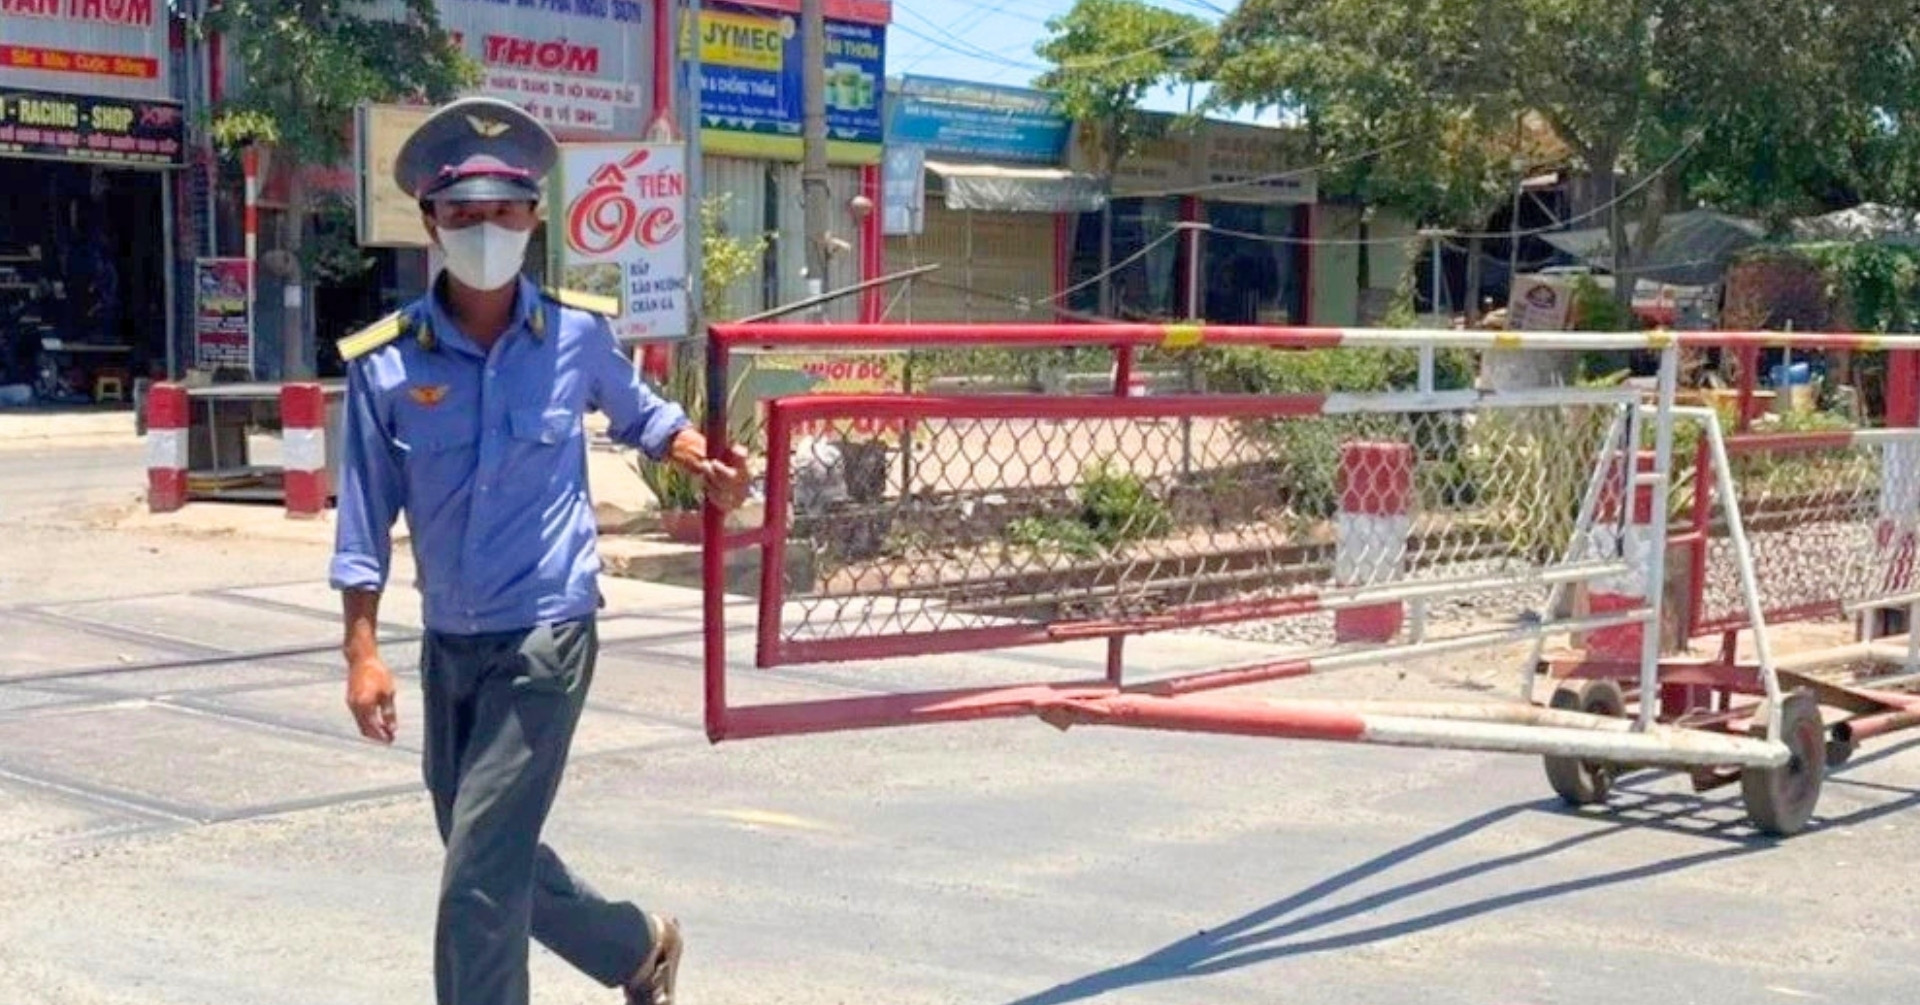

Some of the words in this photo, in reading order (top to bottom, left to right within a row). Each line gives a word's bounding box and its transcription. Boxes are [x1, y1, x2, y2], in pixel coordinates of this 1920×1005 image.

[703, 22, 779, 51] JYMEC
[19, 99, 78, 128] RACING
[92, 105, 133, 131] SHOP
[637, 165, 684, 199] TIẾN
